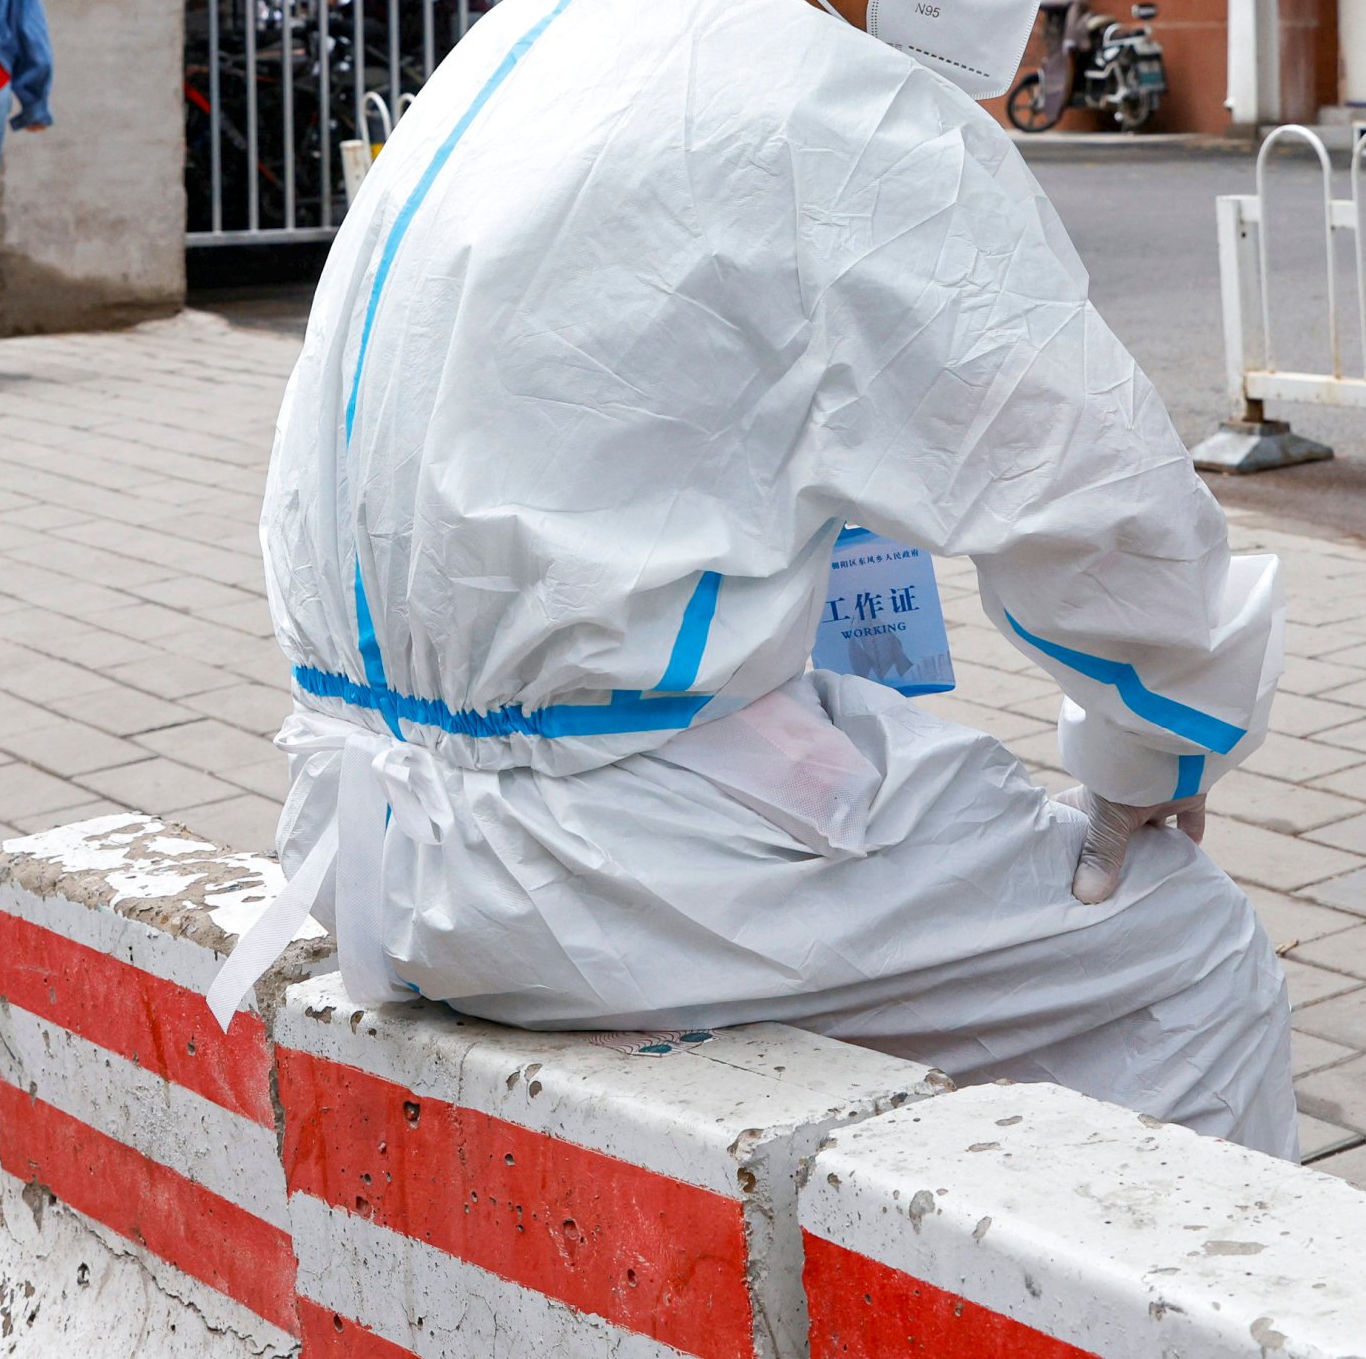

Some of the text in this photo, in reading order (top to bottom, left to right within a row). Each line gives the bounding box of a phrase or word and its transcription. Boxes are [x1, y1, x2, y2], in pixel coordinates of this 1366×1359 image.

[915, 2, 941, 18] N95
[822, 585, 921, 624] 工作证
[841, 622, 907, 640] WORKING
